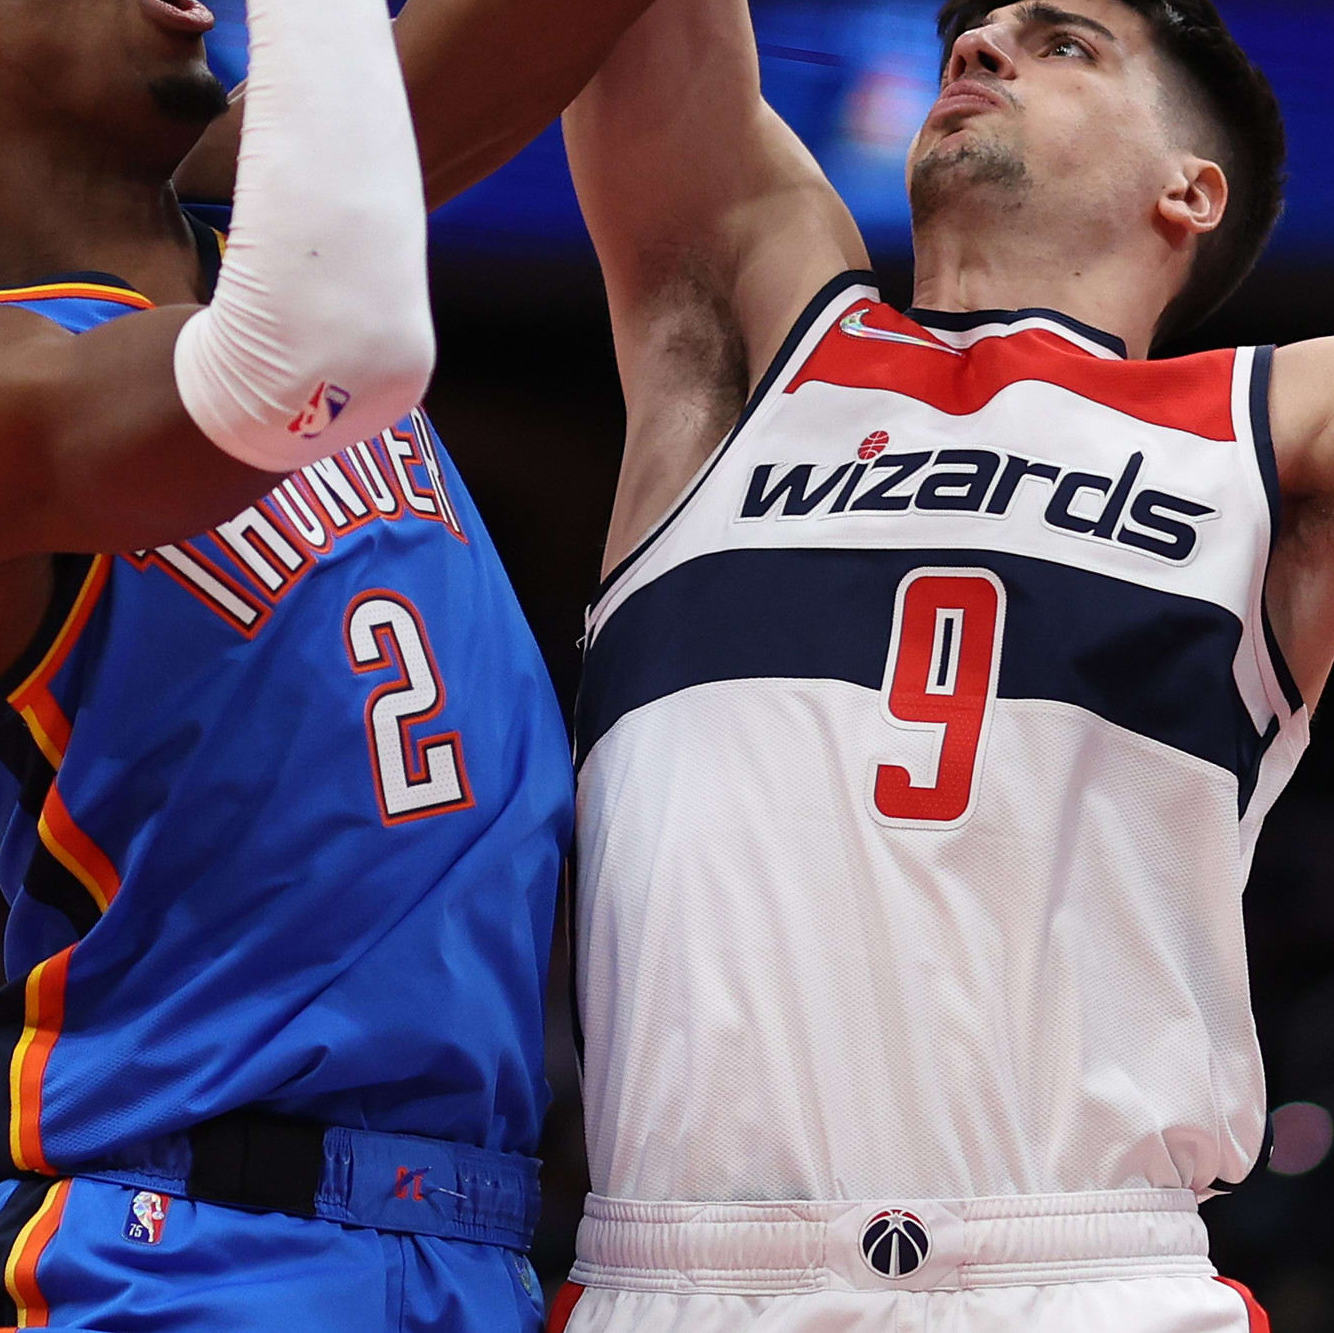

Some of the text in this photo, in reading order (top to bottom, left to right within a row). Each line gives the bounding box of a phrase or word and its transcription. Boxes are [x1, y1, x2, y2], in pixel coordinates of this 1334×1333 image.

[734, 430, 1221, 567] wizards
[342, 587, 475, 826] 2
[867, 567, 1007, 830] 9
[128, 1222, 144, 1238] 75
